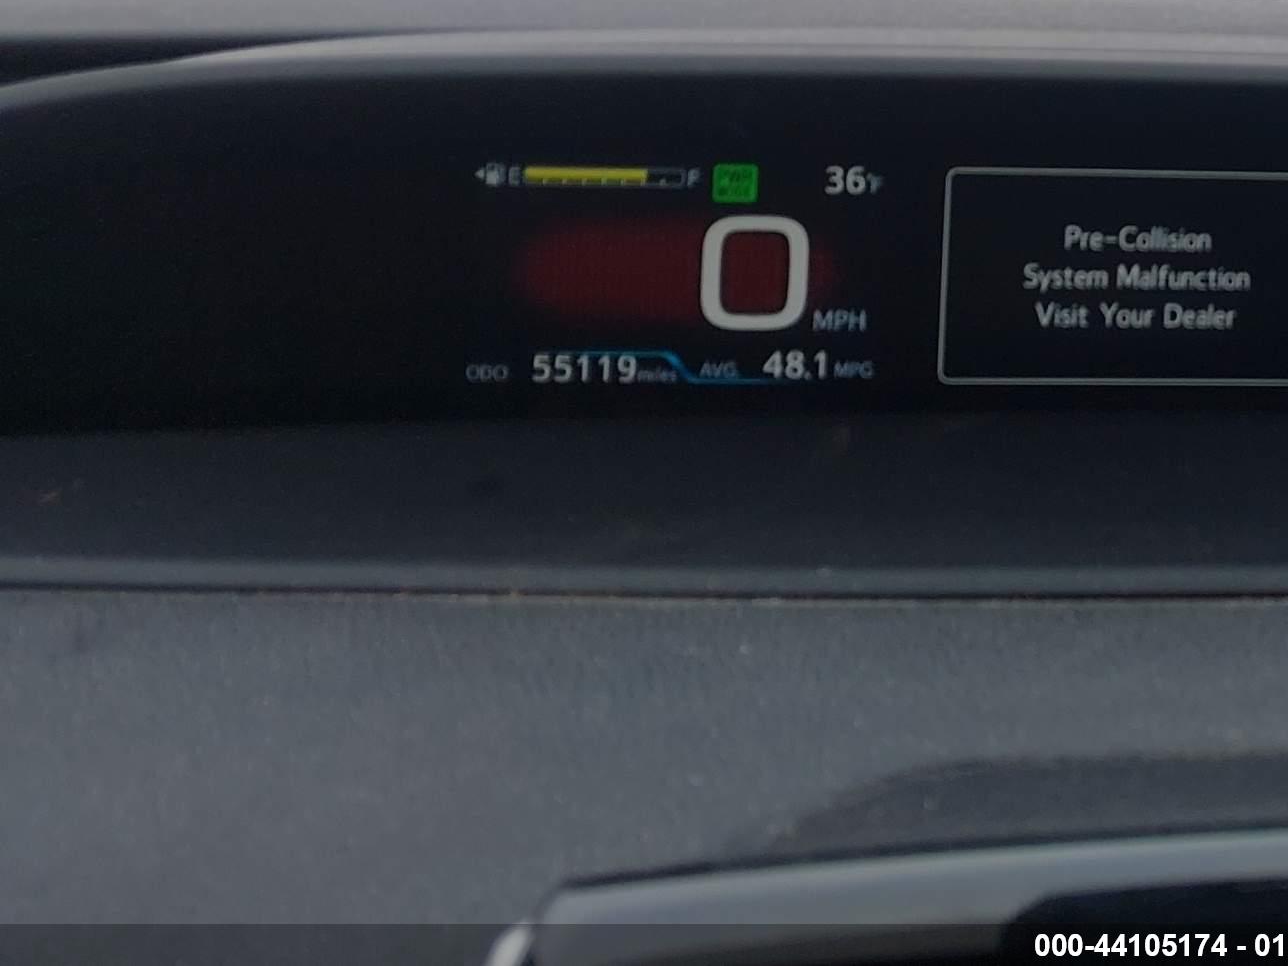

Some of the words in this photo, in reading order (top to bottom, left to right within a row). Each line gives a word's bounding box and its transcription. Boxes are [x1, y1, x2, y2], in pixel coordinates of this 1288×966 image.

[1063, 224, 1213, 253] Pre-Collision
[700, 214, 810, 332] 0
[1023, 262, 1108, 293] System
[1116, 263, 1251, 291] Malfunction
[811, 309, 868, 332] MPH
[1034, 301, 1088, 328] Visit
[1100, 301, 1154, 328] Your
[1163, 303, 1236, 330] Dealer
[531, 353, 637, 384] 55119
[762, 350, 828, 380] 48.1
[834, 361, 874, 379] MPG
